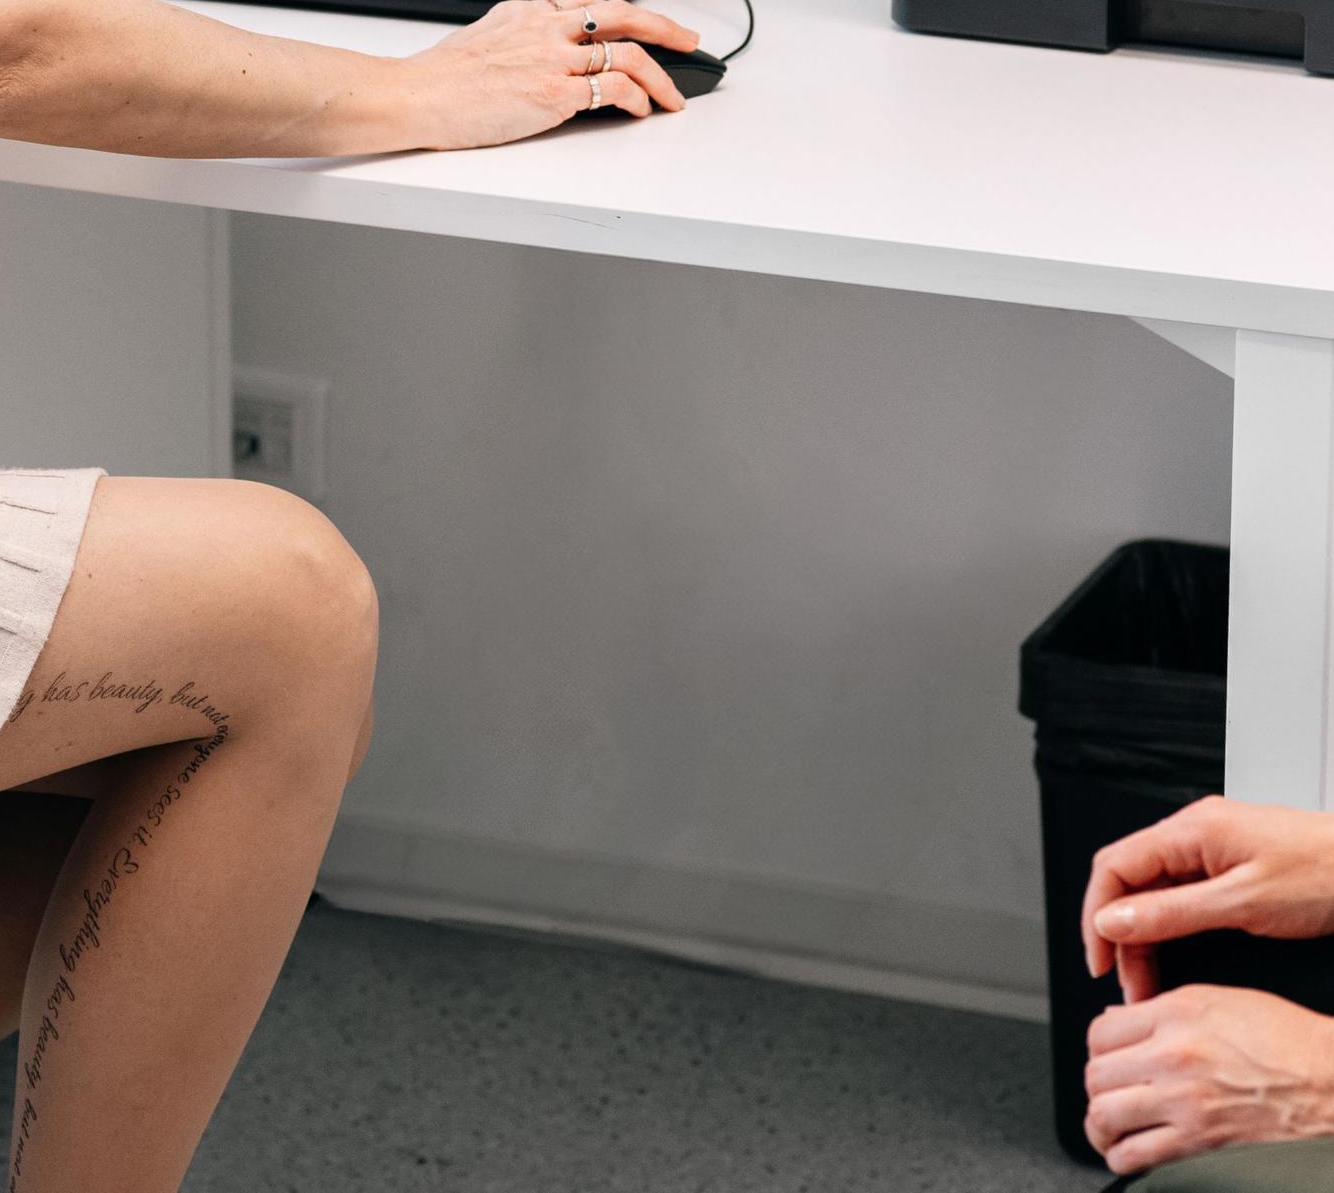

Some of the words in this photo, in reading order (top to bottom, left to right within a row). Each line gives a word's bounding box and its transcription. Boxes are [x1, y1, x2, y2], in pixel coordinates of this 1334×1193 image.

[42, 671, 89, 703] has
[89, 671, 163, 713] beauty,
[170, 681, 208, 710] but
[201, 704, 229, 725] not
[59, 847, 139, 972] Everything
[47, 974, 76, 1019] has
[22, 1098, 38, 1139] but
